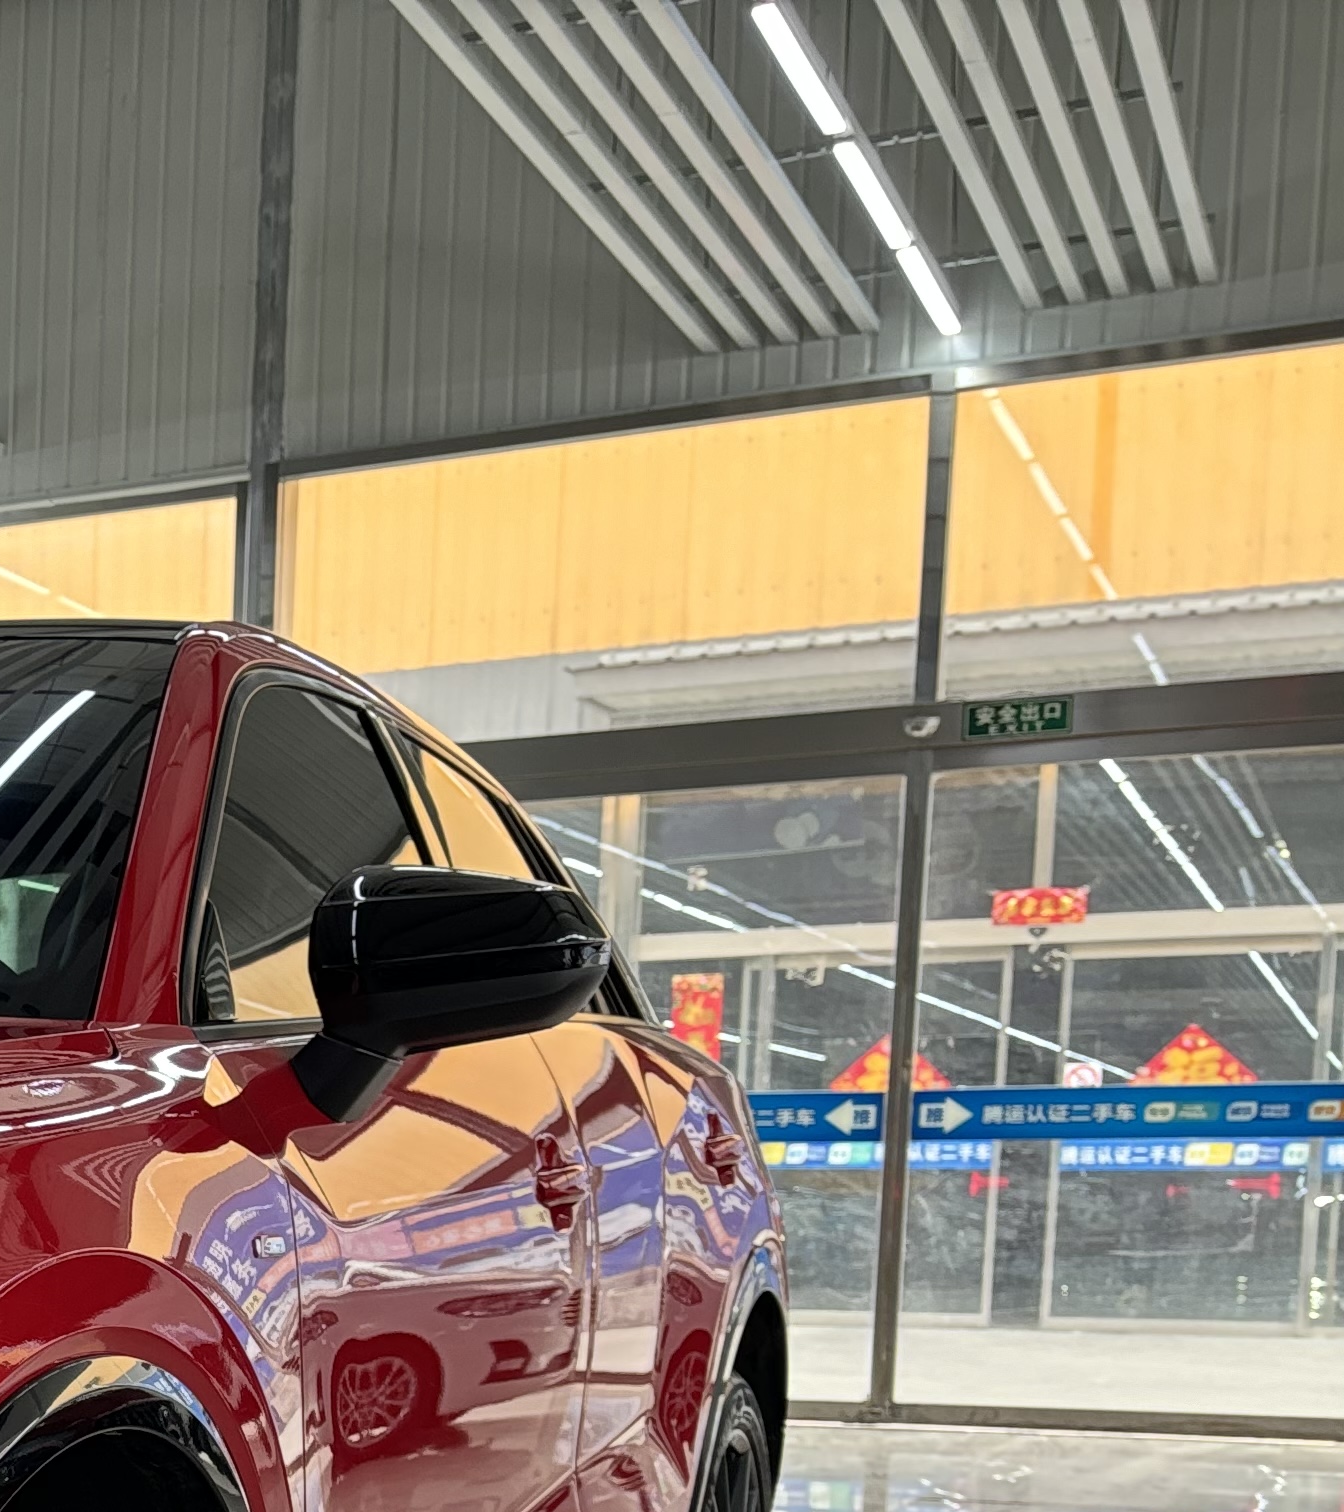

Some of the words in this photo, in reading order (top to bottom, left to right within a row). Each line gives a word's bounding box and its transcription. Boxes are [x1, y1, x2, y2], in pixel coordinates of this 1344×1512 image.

[975, 702, 1061, 727] 安全出口
[988, 720, 1044, 735] EXIT
[752, 1108, 816, 1127] 二手车
